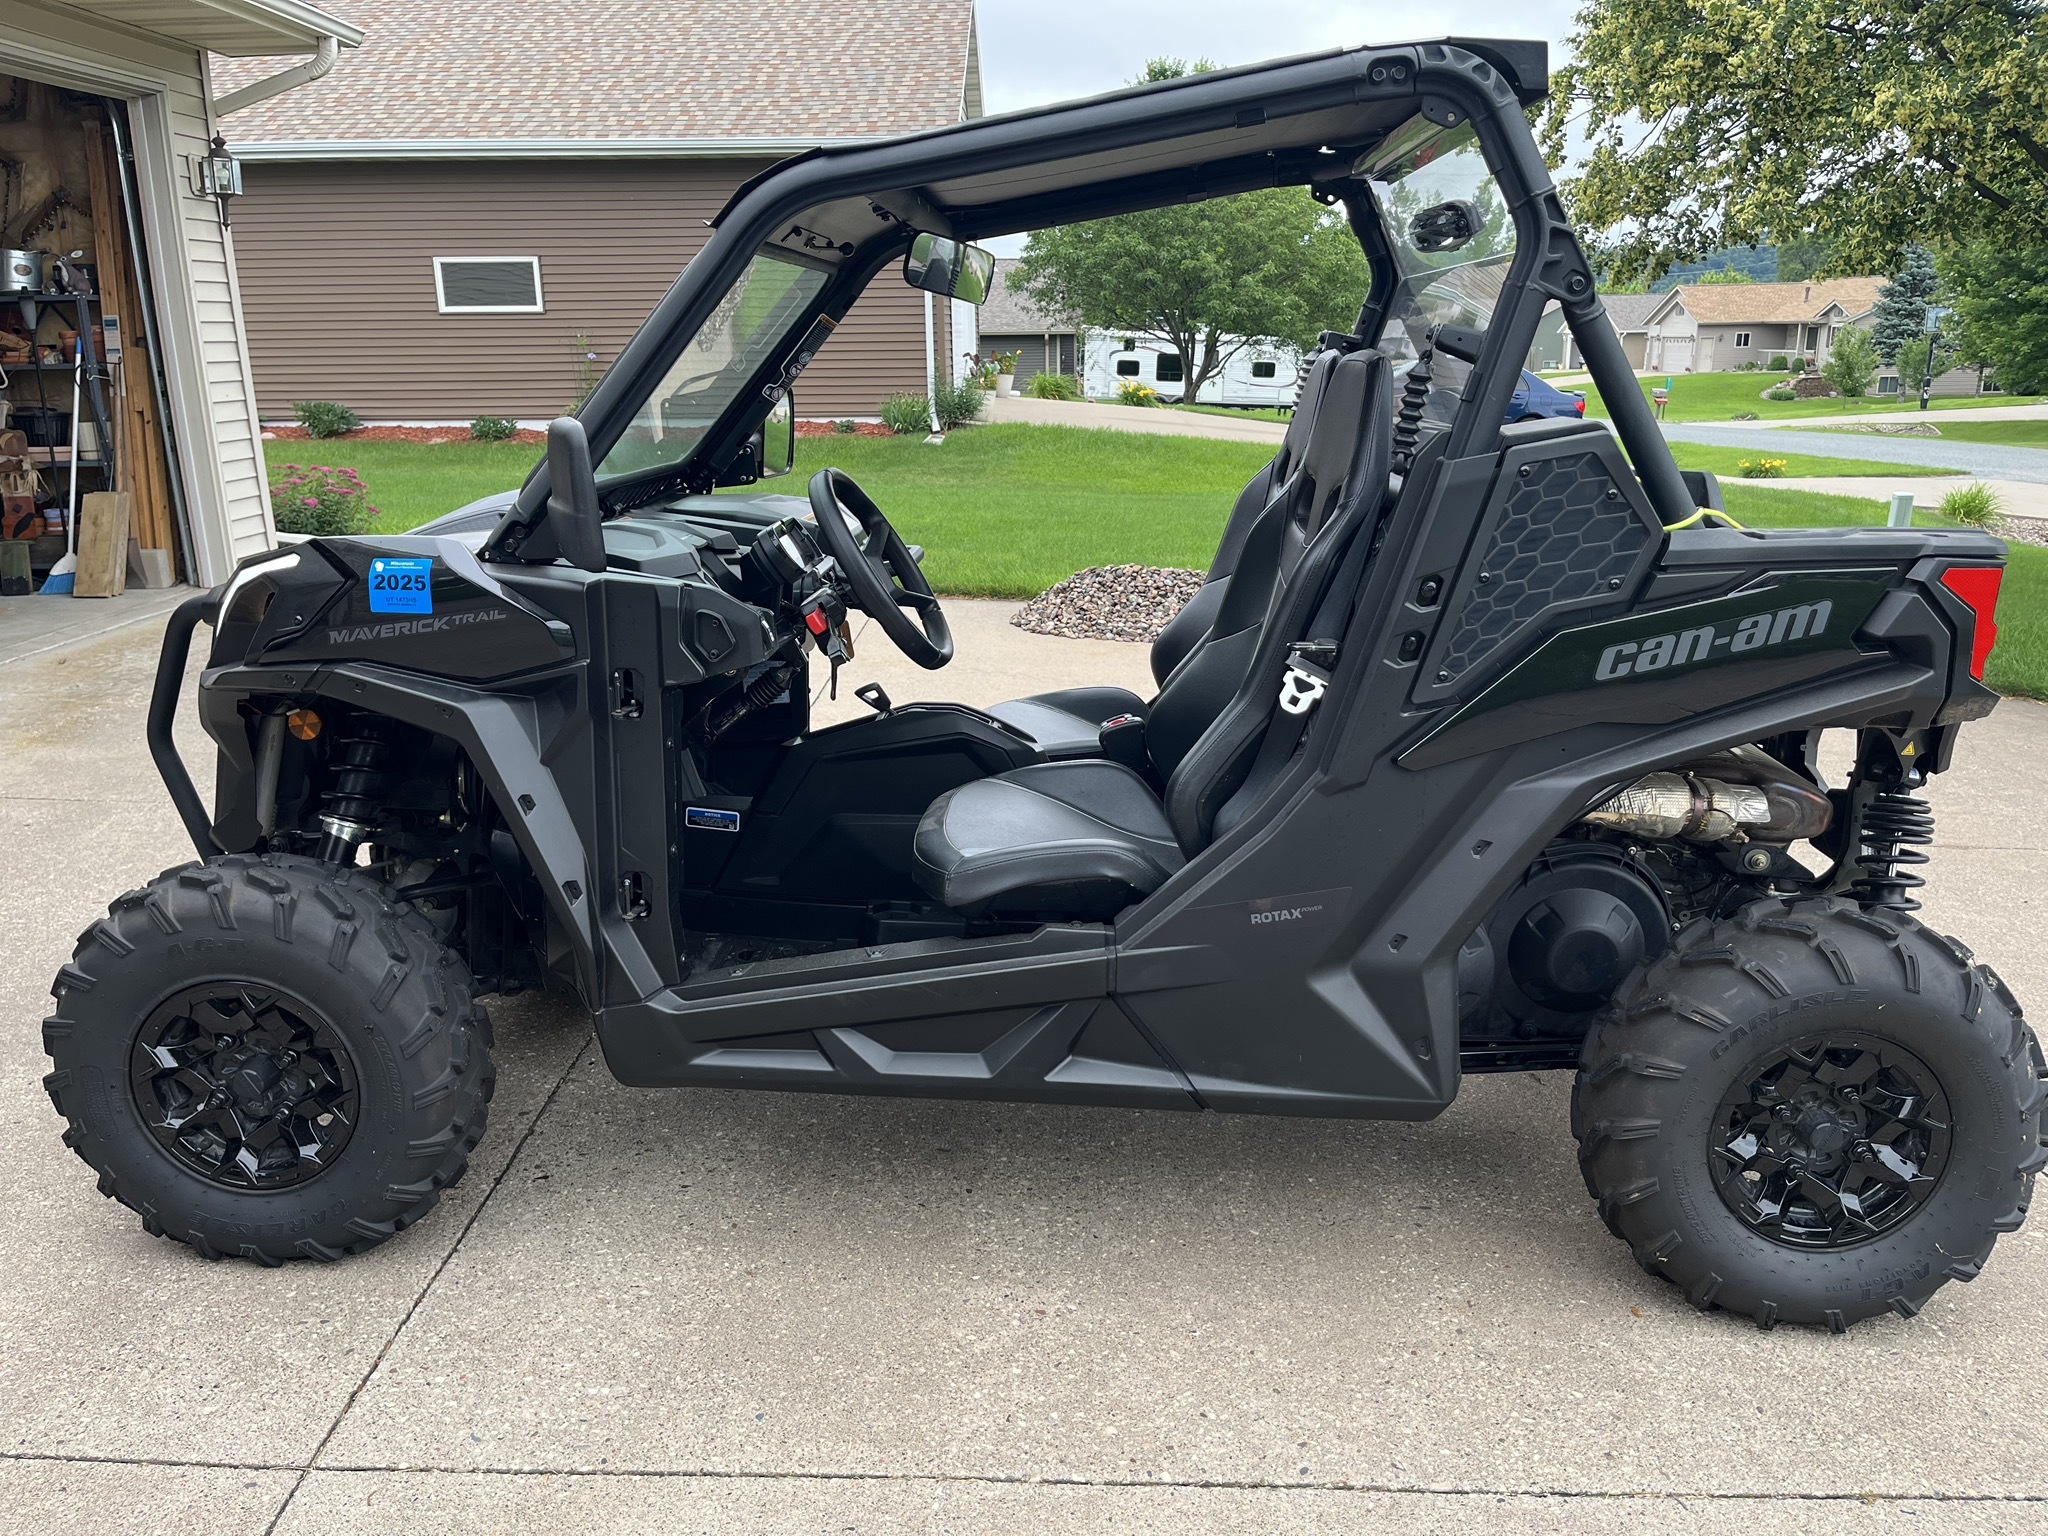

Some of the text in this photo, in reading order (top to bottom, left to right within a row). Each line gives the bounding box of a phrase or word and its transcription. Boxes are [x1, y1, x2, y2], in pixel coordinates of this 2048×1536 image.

[373, 573, 427, 592] 2025
[328, 609, 507, 645] MAVERICK TRAIL
[1594, 599, 1833, 681] can-am
[1250, 904, 1323, 925] ROTAX POWER
[1709, 988, 1870, 1062] CARLISLE
[187, 1198, 350, 1238] CARLISLE
